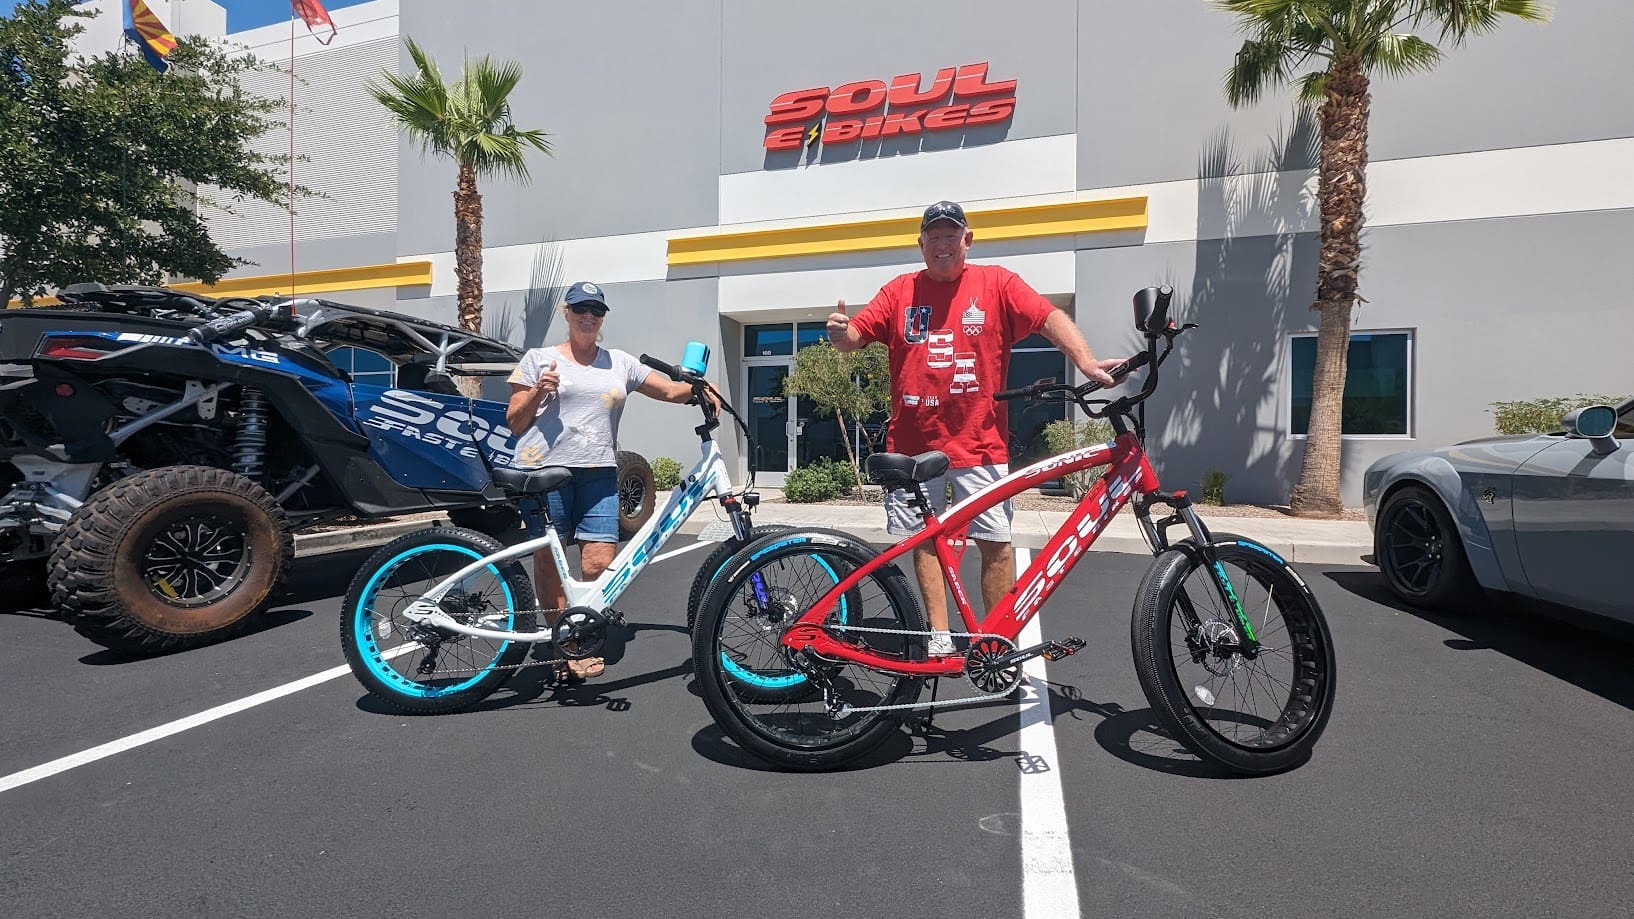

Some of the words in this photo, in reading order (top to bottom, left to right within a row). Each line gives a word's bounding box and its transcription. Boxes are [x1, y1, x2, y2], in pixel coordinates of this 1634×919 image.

[764, 61, 1018, 125] SOUL
[763, 125, 806, 150] E
[820, 96, 1017, 145] BIKES
[363, 416, 462, 449] FAST
[1024, 448, 1099, 479] SONIC
[602, 471, 716, 603] SOUL
[1013, 466, 1142, 621] SOUL
